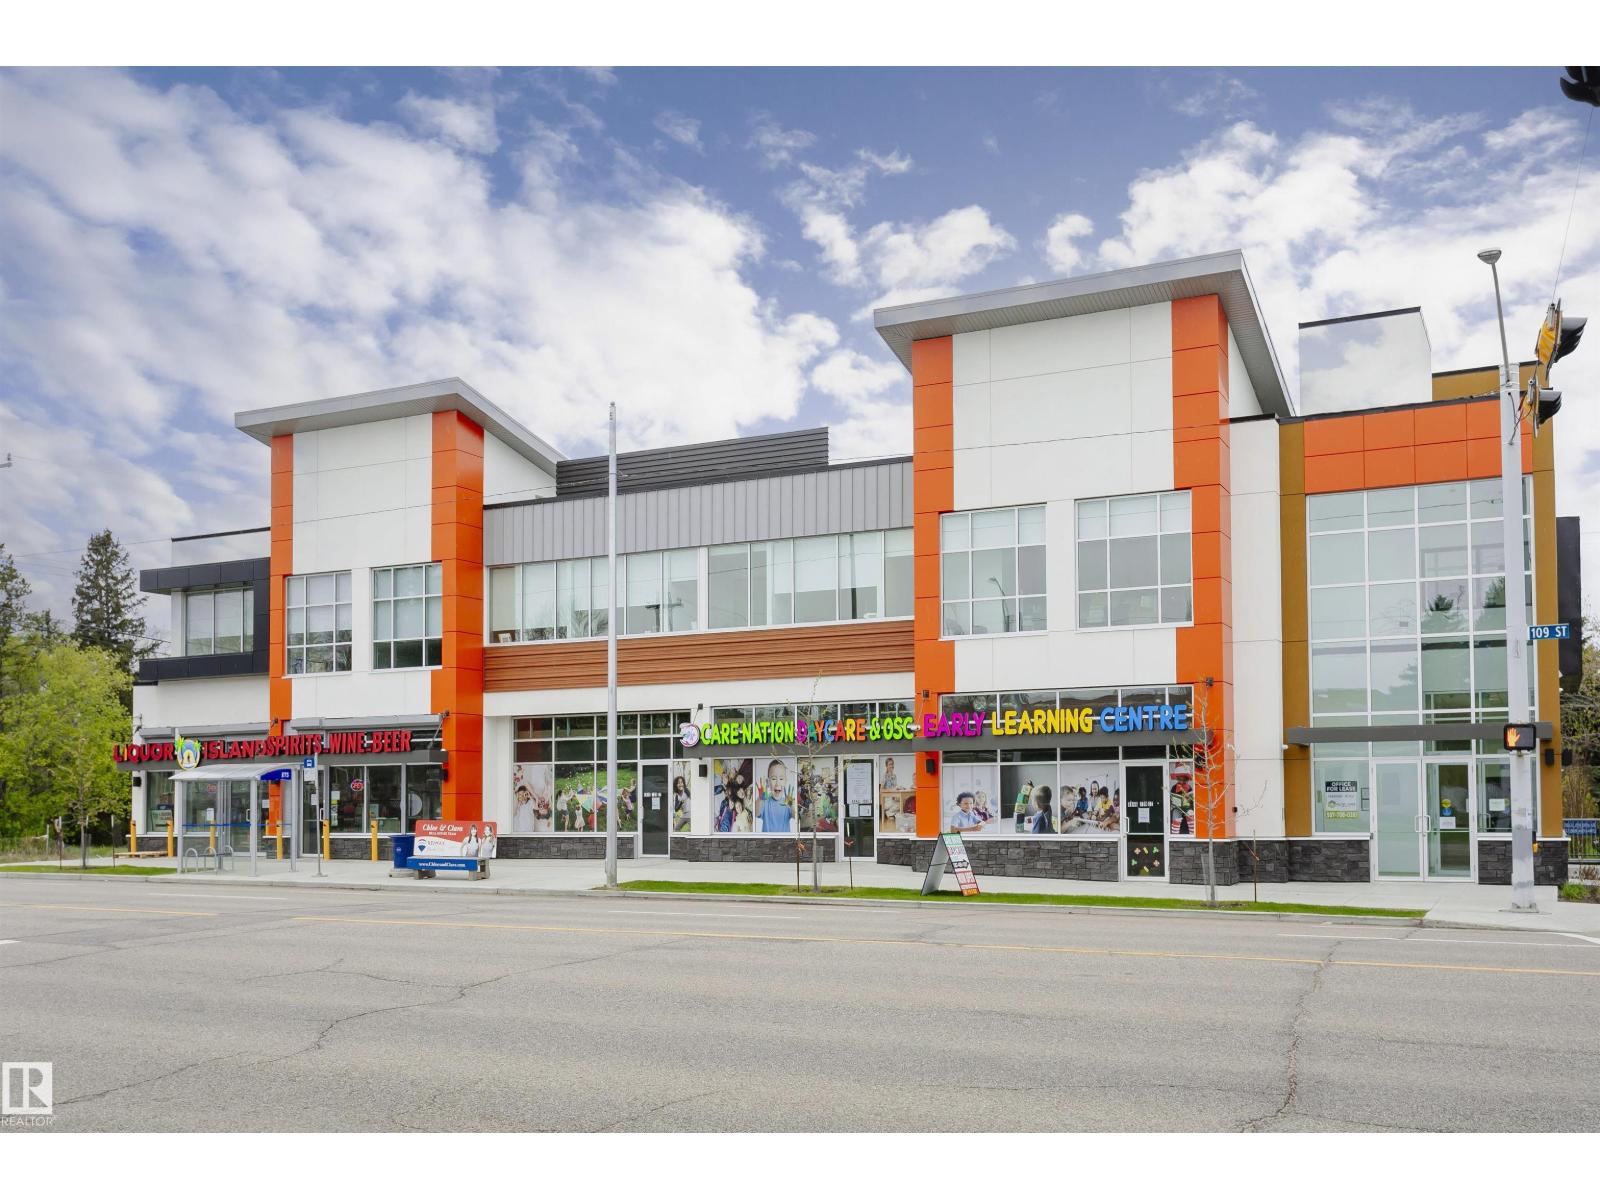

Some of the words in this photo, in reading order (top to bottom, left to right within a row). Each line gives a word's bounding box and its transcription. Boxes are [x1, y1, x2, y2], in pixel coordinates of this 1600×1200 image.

[1531, 627, 1549, 638] 109
[1555, 626, 1567, 637] ST
[700, 722, 740, 746] CARE
[741, 719, 795, 745] NATION
[796, 718, 868, 744] DAYCARE
[870, 716, 881, 741] &
[882, 716, 914, 741] OSC
[924, 712, 986, 737] EARLY
[992, 708, 1094, 736] LEARNING
[1100, 704, 1190, 733] CENTRE
[113, 742, 175, 764] LIQUOR
[203, 739, 267, 760] ISLAND
